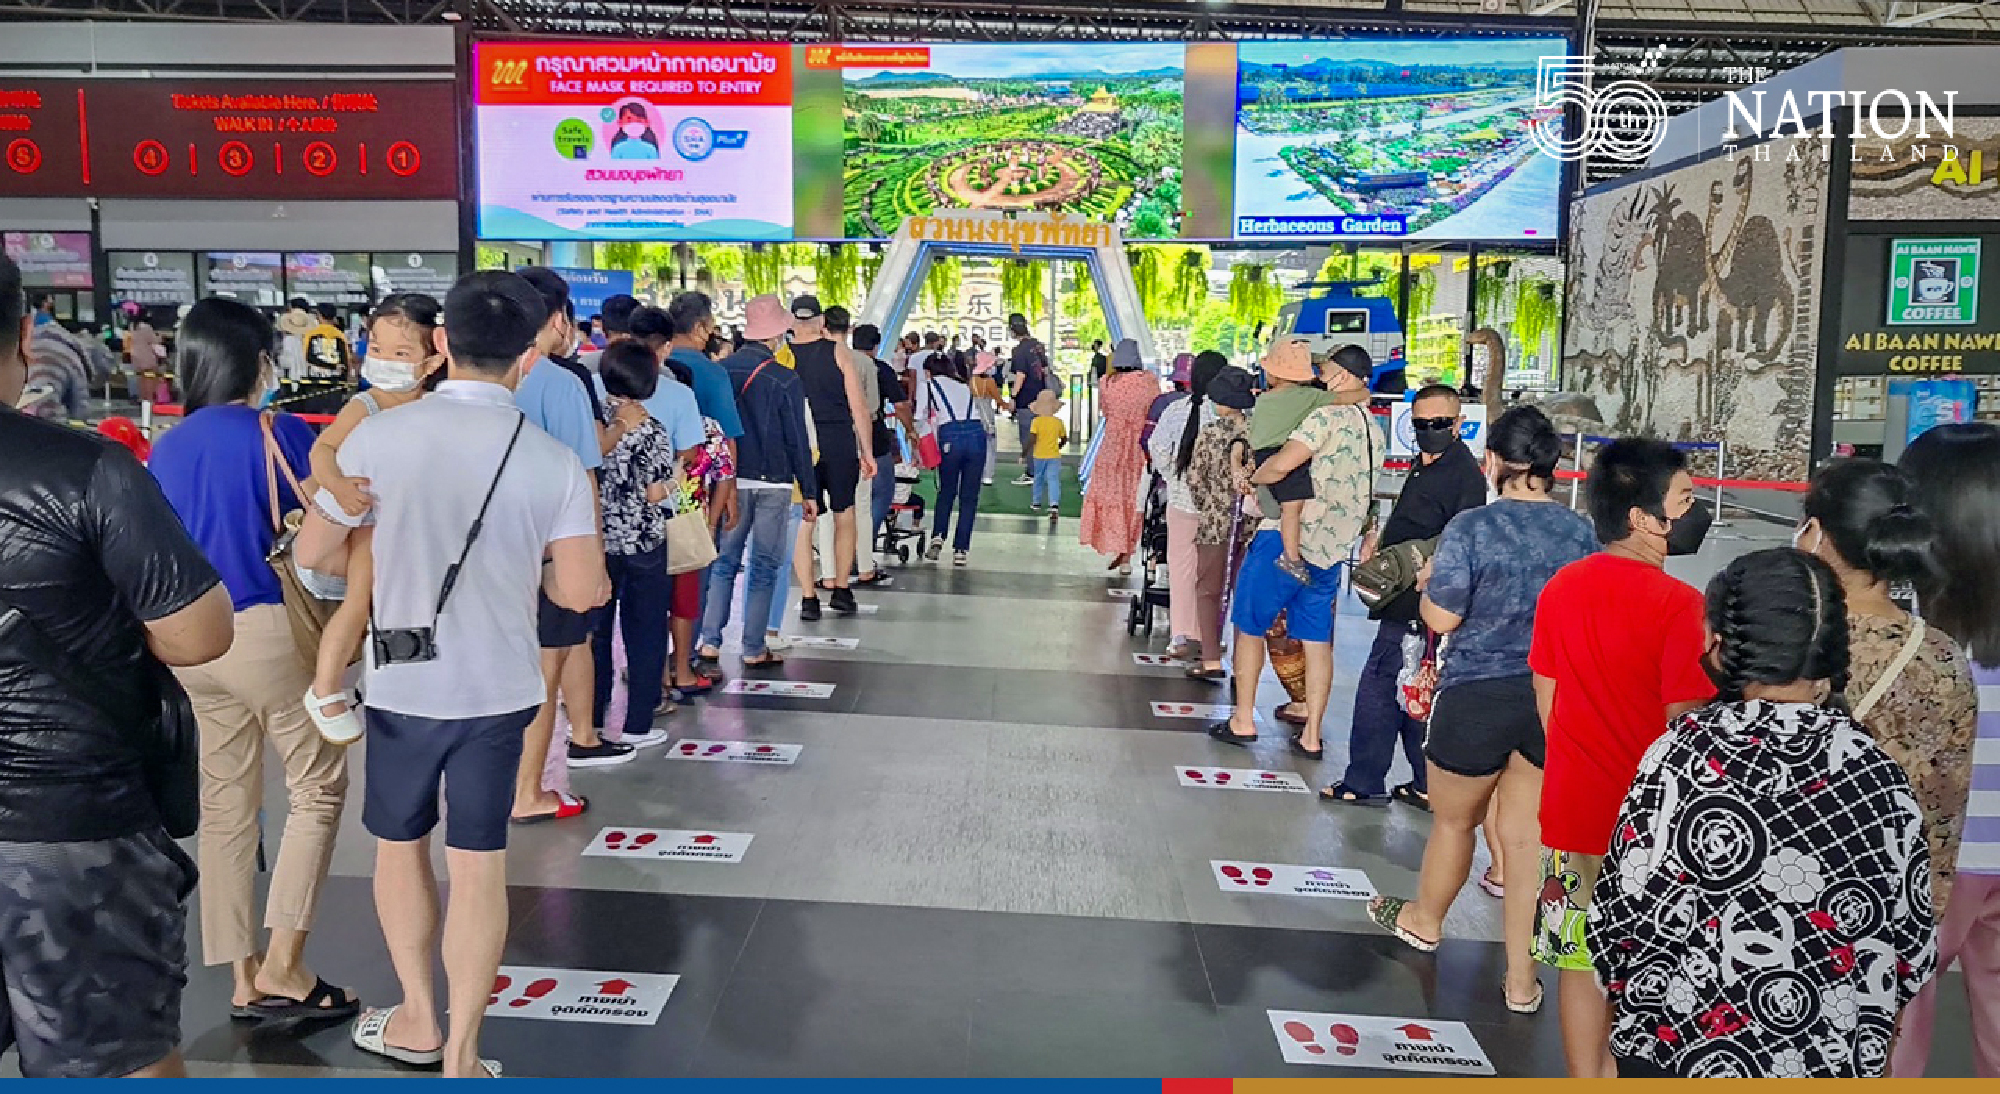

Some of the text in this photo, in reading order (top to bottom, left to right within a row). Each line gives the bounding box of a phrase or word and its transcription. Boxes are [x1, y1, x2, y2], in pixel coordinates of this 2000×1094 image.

[535, 50, 777, 79] กรุณาสวมหน้ากากอนามัย
[549, 80, 762, 94] FACE MASK REQUIRED TO ENTRY
[213, 116, 256, 131] WALK
[257, 116, 273, 131] IN
[1930, 148, 1982, 185] AI
[908, 211, 1112, 254] สวนนงนุชพัทยา
[1240, 218, 1402, 234] Herbaceous Garden
[1902, 307, 1961, 320] COFFEE
[1845, 333, 1870, 350] AI
[1875, 333, 1939, 350] BAAN
[1889, 355, 1962, 371] COFFEE
